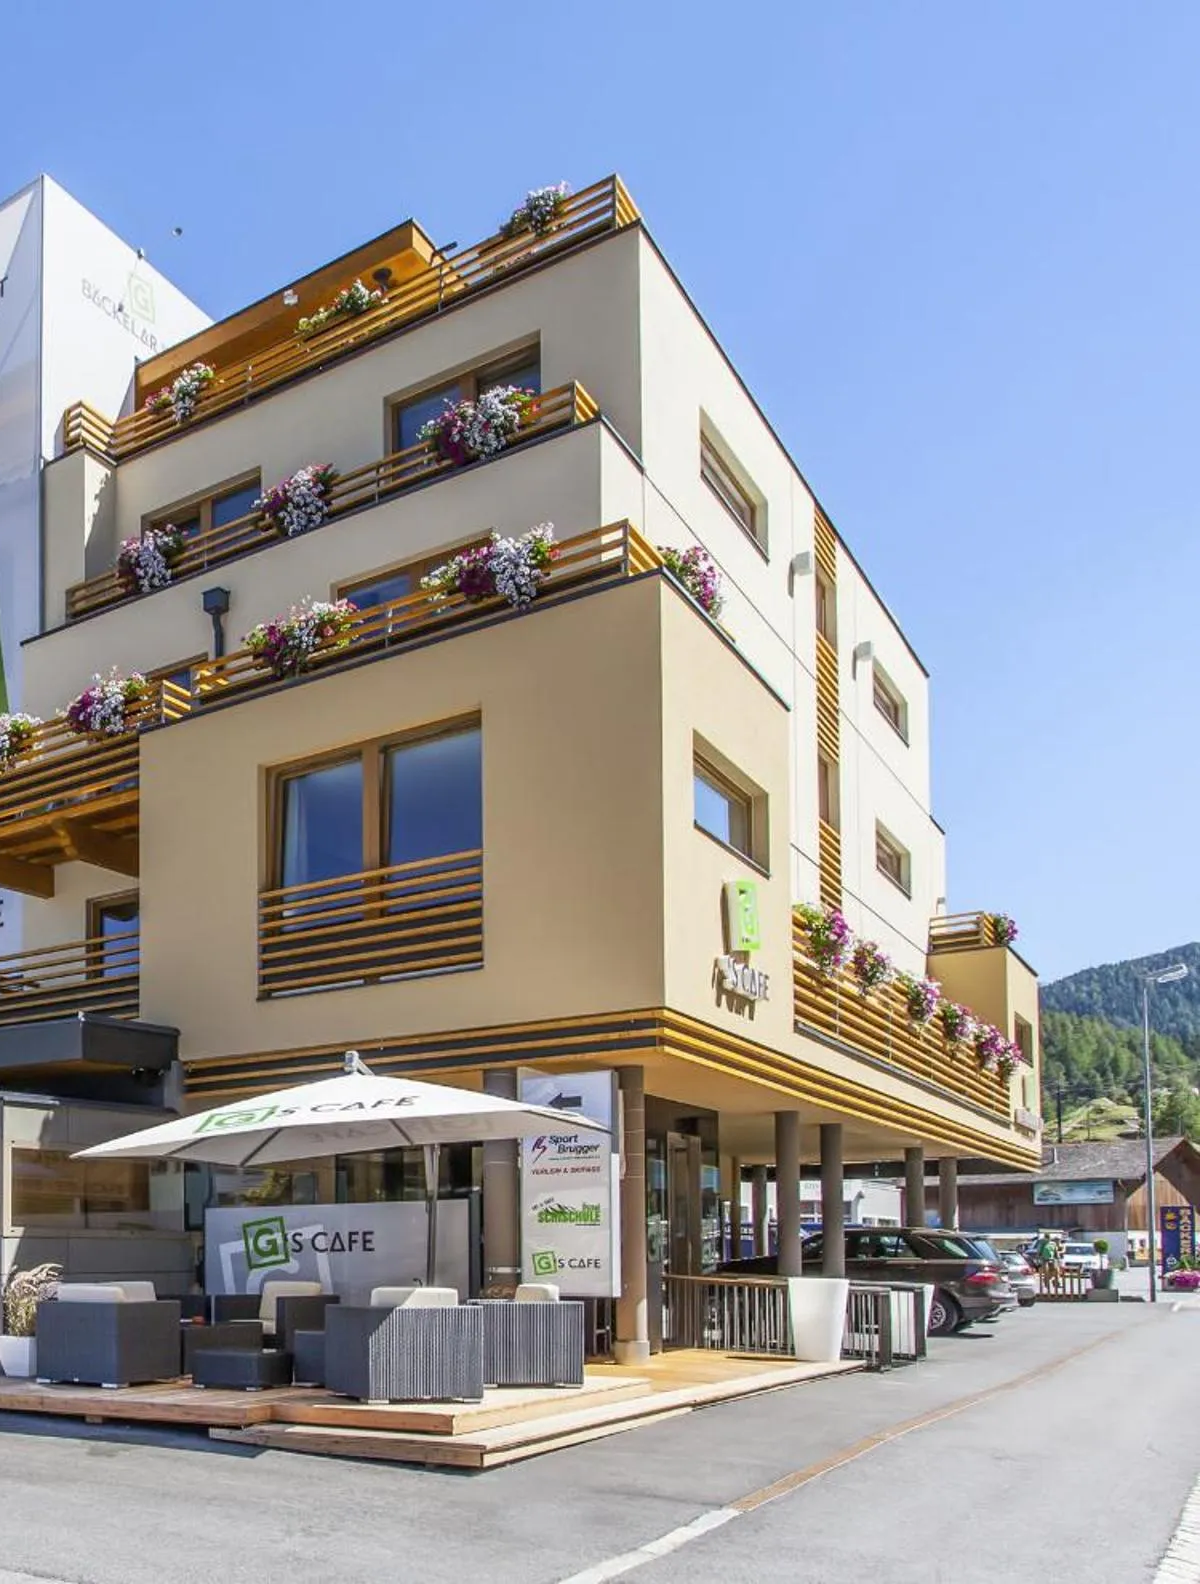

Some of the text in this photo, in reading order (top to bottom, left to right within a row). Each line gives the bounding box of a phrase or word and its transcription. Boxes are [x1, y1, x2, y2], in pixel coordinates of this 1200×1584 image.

[310, 1095, 422, 1113] CAFE
[548, 1134, 578, 1146] Sport
[311, 1231, 375, 1253] CAFE
[568, 1258, 601, 1269] CAFE
